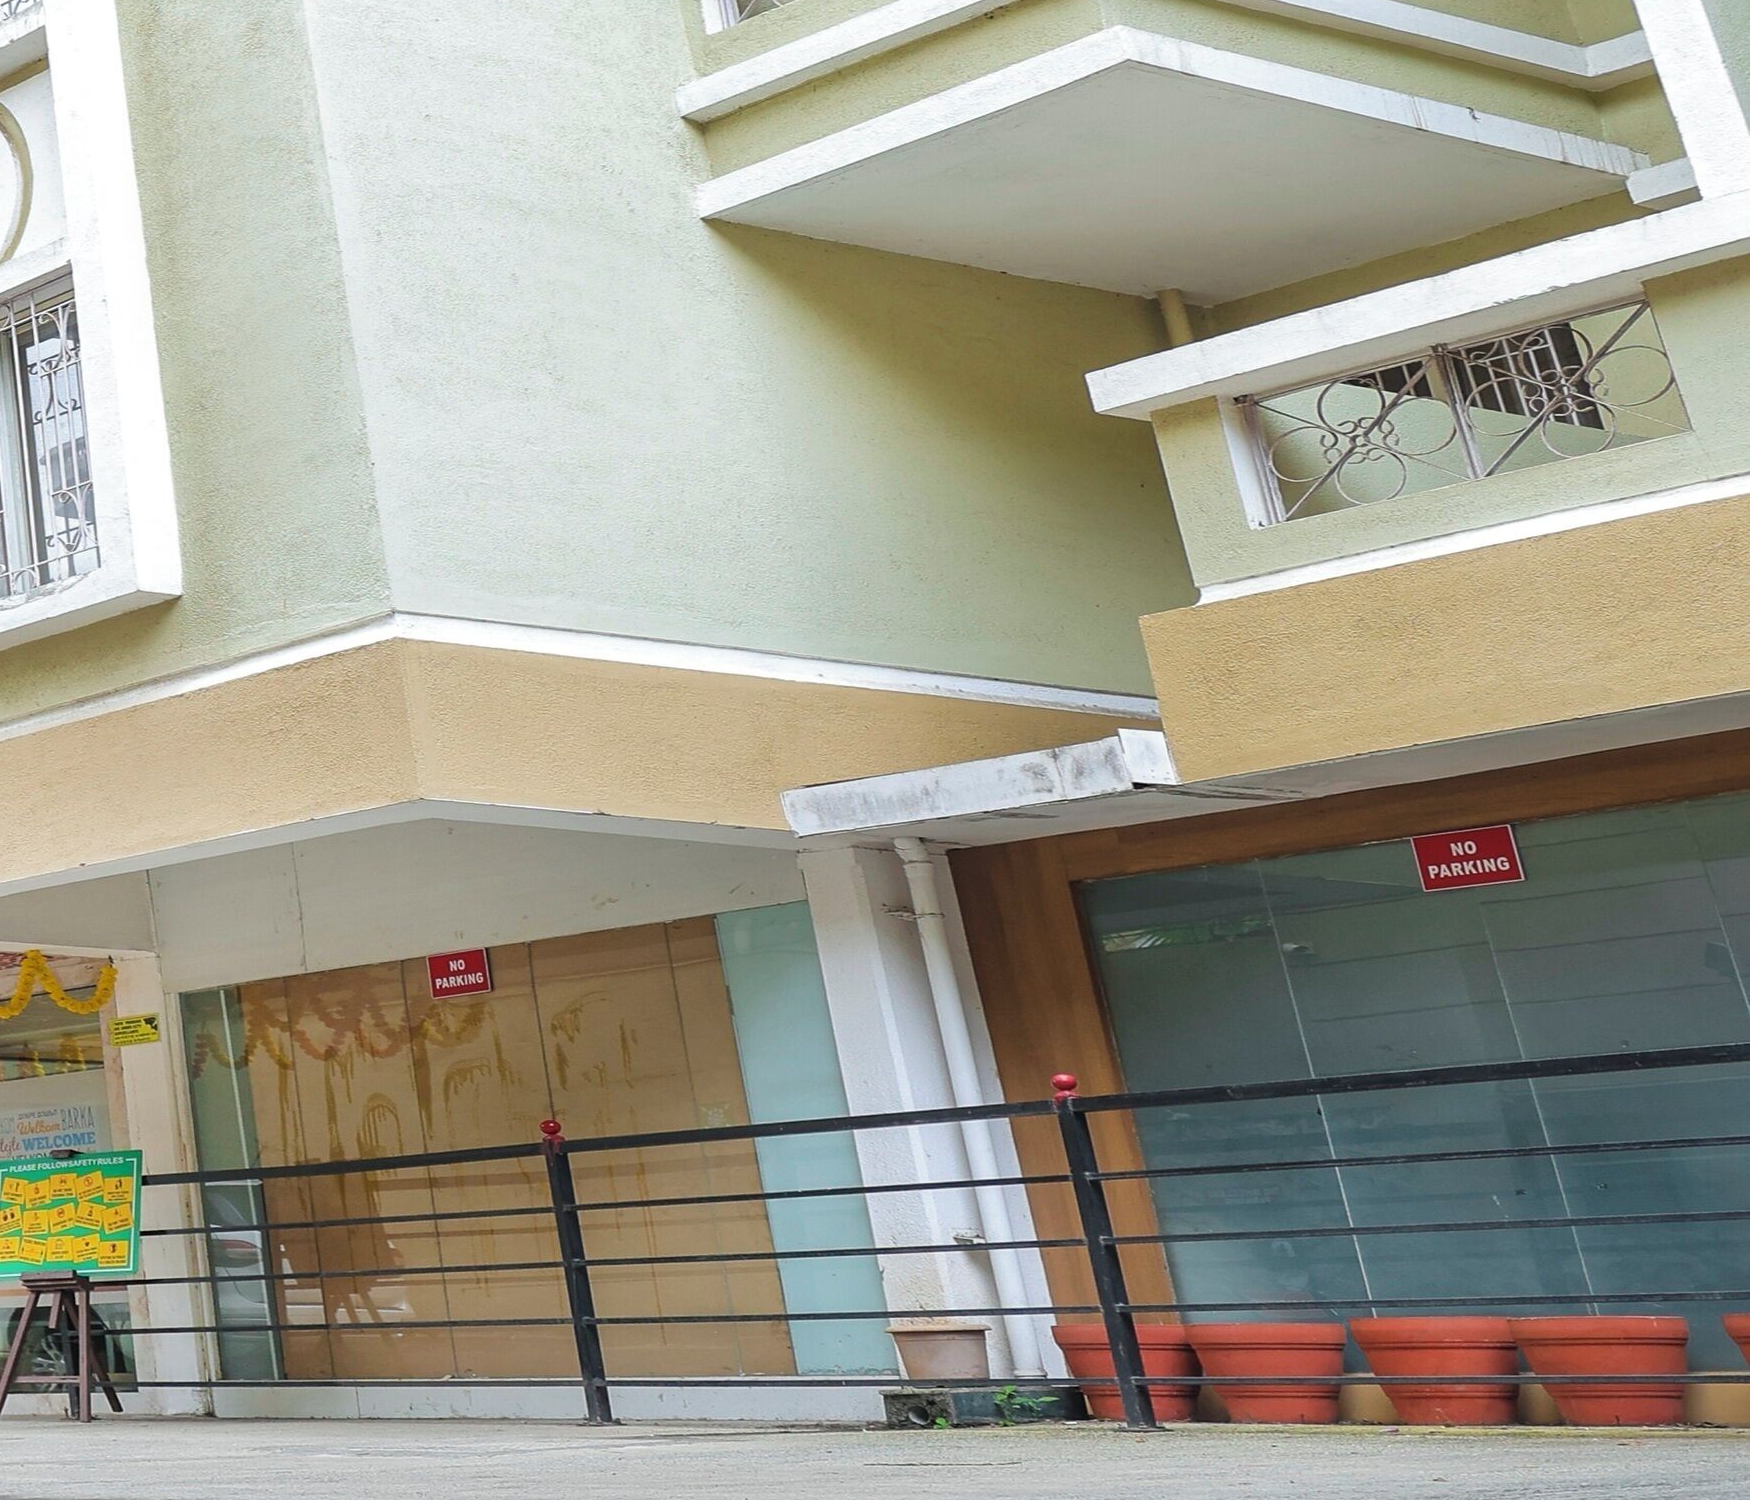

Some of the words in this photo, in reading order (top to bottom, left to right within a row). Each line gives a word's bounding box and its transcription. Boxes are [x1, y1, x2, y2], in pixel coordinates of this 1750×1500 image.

[1449, 840, 1477, 857] NO
[1427, 856, 1511, 879] PARKING
[449, 959, 466, 972] NO
[435, 972, 484, 990] PARKING
[21, 1132, 97, 1152] WELCOME
[9, 1162, 37, 1173] PLEASE
[37, 1161, 67, 1171] FOLLOW
[67, 1158, 97, 1168] SAFETY
[97, 1156, 125, 1166] RULES
